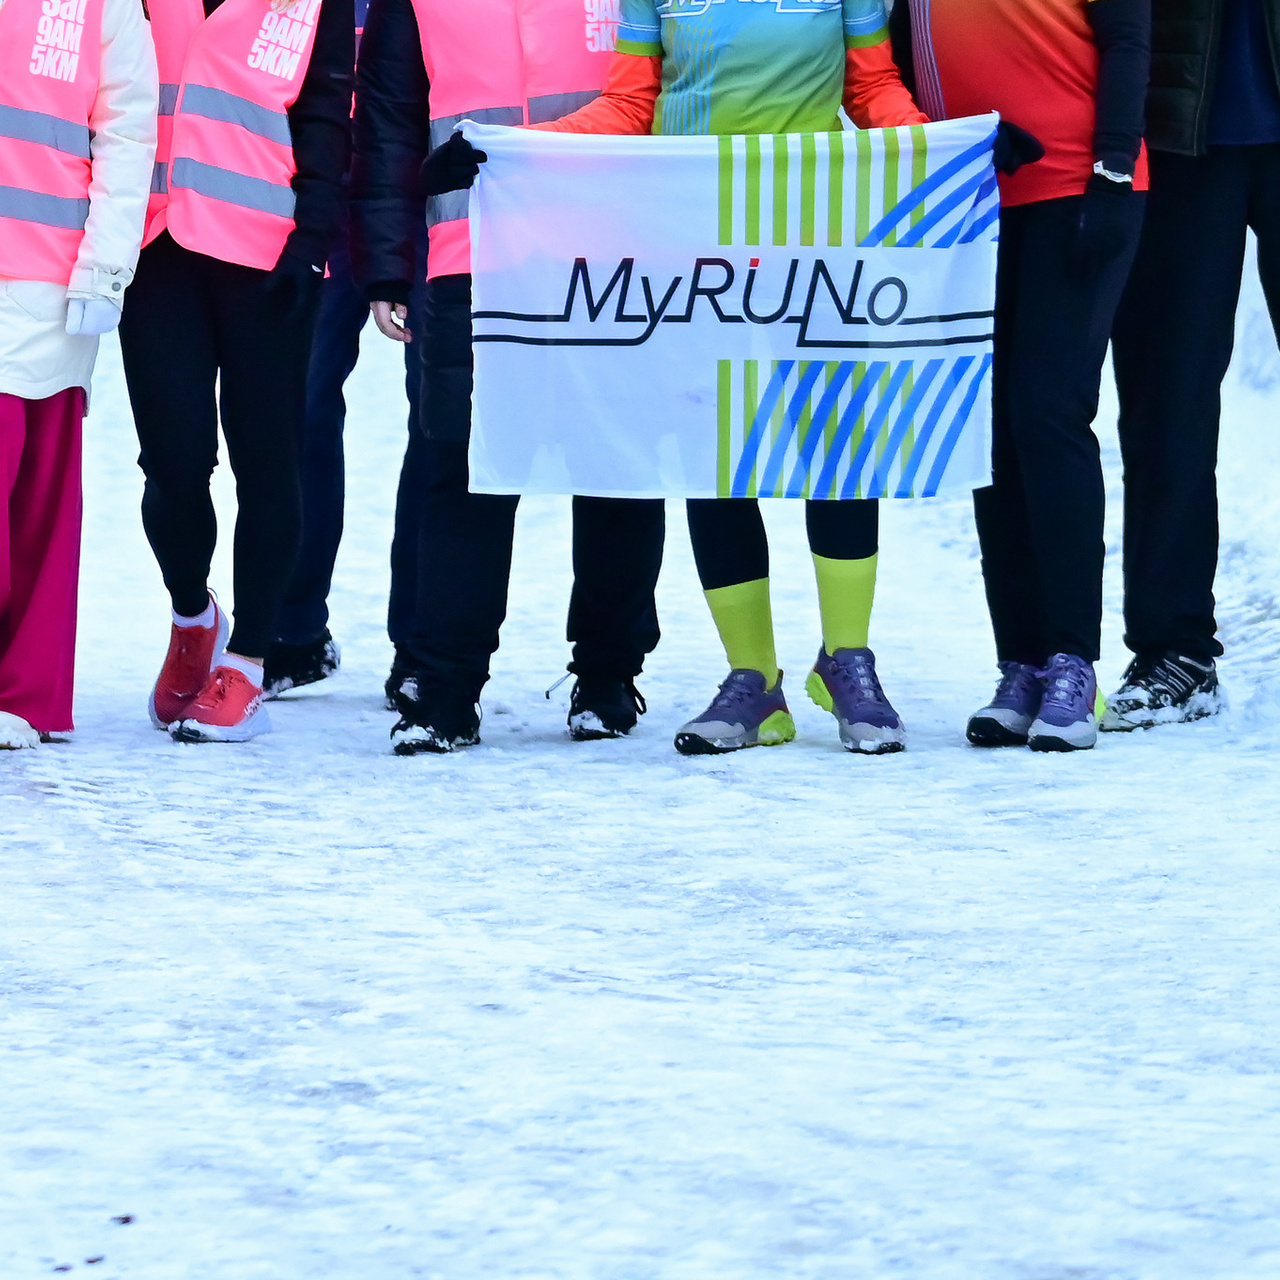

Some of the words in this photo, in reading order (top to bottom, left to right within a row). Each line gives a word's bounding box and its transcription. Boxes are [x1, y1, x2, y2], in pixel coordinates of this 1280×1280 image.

[35, 15, 84, 54] 9AM
[258, 11, 313, 54] 9AM
[585, 22, 618, 53] 5K
[29, 44, 80, 83] 5KM
[246, 37, 302, 81] 5KM
